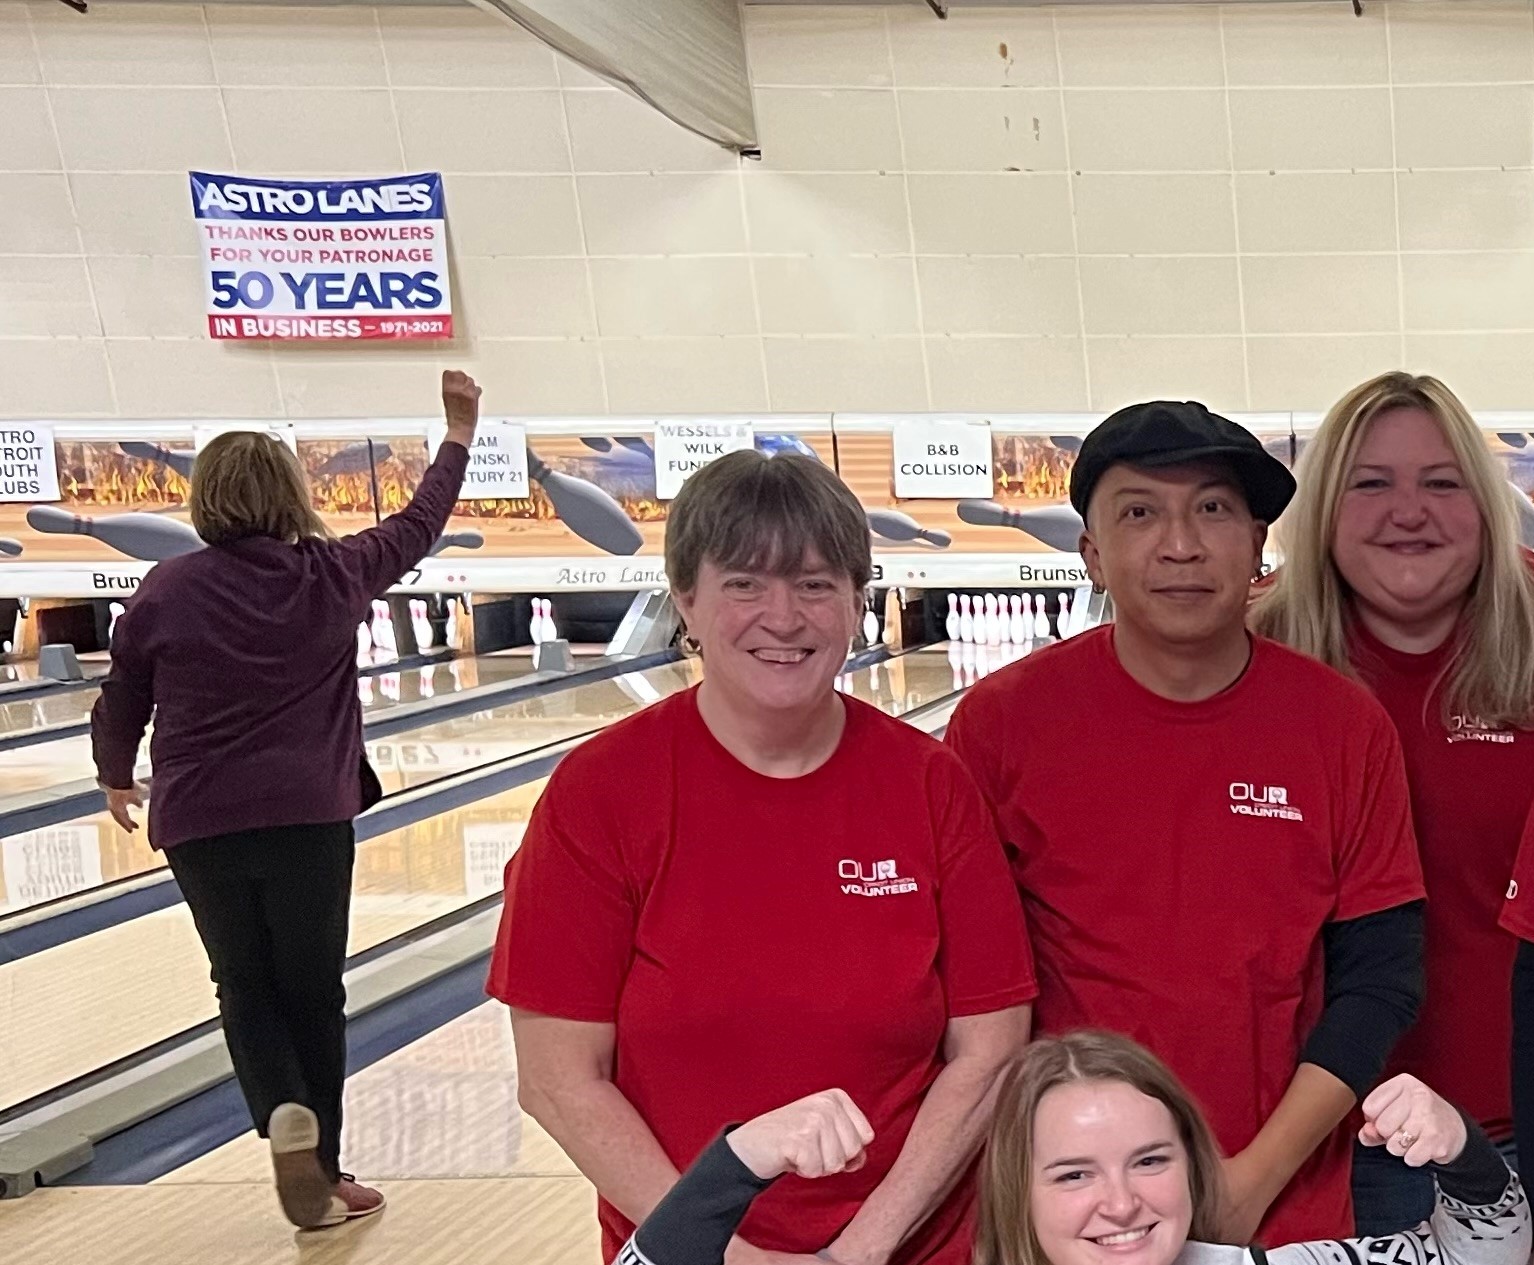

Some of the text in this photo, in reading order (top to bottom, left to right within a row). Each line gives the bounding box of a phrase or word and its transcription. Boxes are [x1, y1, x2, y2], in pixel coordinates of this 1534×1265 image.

[200, 182, 433, 214] ASTRO LANES
[205, 226, 434, 242] THANKS OUR BOWLERS
[210, 248, 433, 264] FOR YOUR PATRONAGE
[212, 270, 442, 310] 50 YEARS
[215, 319, 236, 338] IN
[243, 319, 362, 338] BUSINESS
[380, 320, 444, 334] 1971-2021
[0, 430, 35, 444] TRO
[660, 425, 731, 438] WESSELS
[470, 436, 498, 448] AM
[684, 443, 724, 454] WILK
[0, 447, 44, 461] ROIT
[927, 444, 960, 456] B&B
[472, 454, 510, 465] INSKI
[0, 464, 38, 478] UTH
[466, 471, 522, 482] TURY 21
[900, 464, 988, 476] COLLISION
[0, 480, 40, 495] UBS
[92, 573, 142, 588] Brun
[556, 567, 668, 584] Astro Lane
[1020, 565, 1088, 581] Brunsw
[1230, 804, 1303, 822] VOLUNTEER
[840, 882, 918, 897] VOLUNTEER
